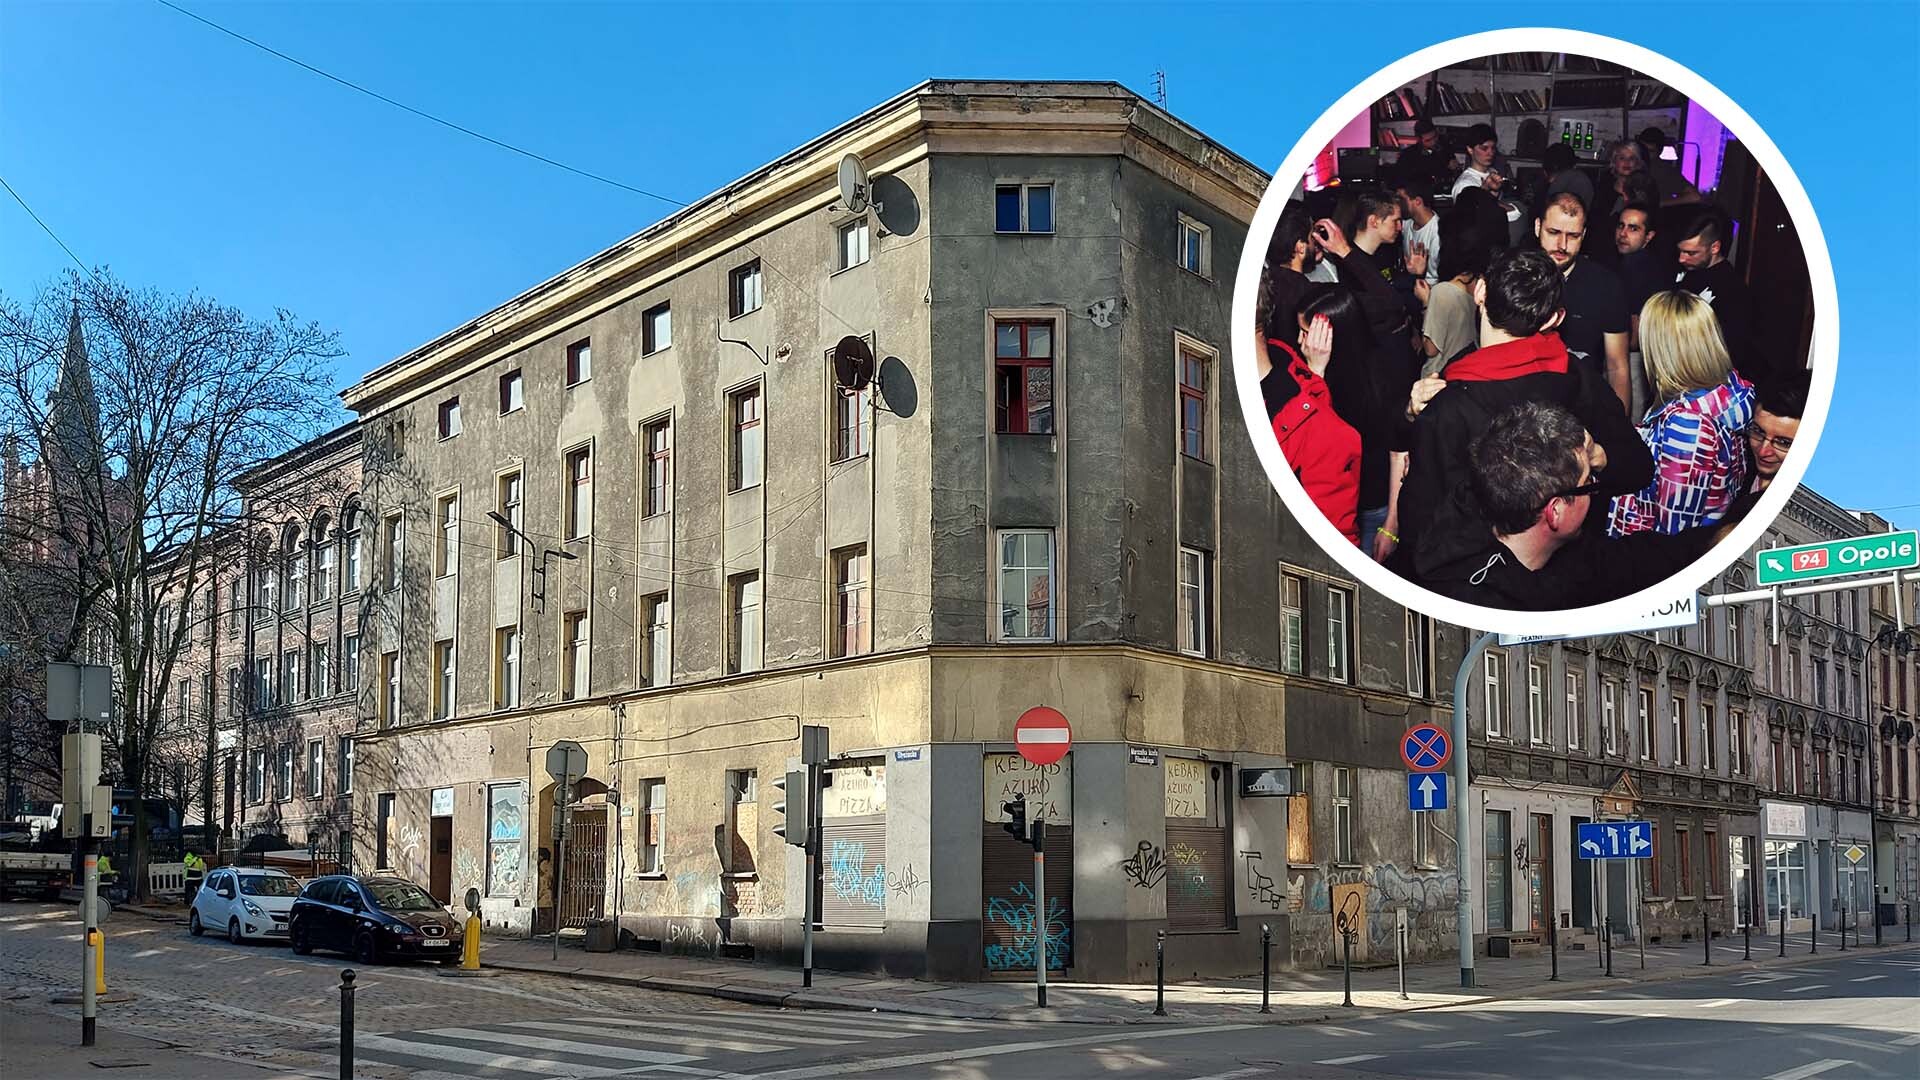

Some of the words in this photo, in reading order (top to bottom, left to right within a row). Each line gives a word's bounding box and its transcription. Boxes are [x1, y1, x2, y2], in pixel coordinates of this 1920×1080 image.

[1799, 553, 1820, 567] 94
[1838, 540, 1912, 566] Opole
[1168, 762, 1200, 780] KEBAB
[1002, 778, 1050, 796] AZURO
[1167, 796, 1200, 817] PIZZA
